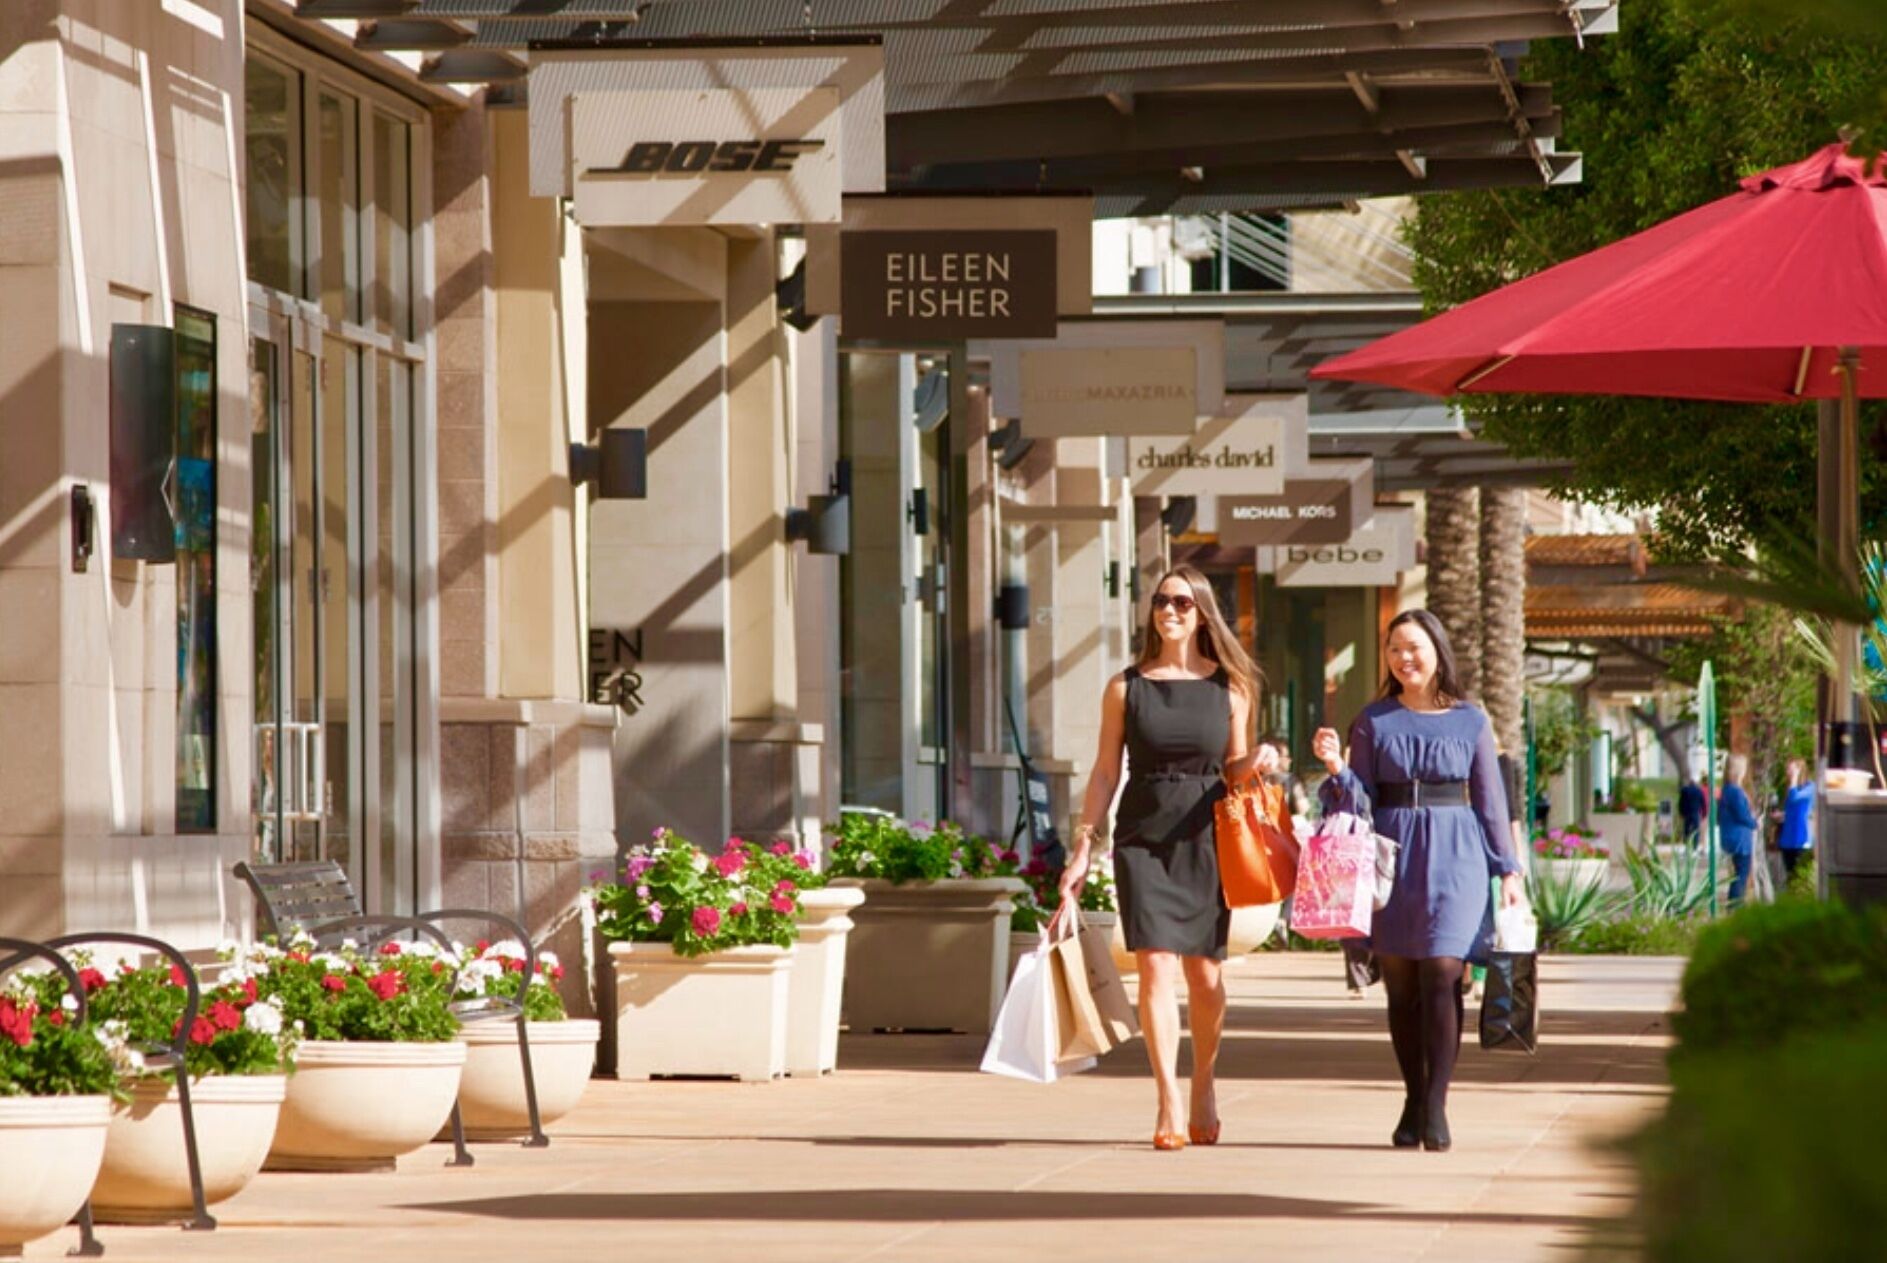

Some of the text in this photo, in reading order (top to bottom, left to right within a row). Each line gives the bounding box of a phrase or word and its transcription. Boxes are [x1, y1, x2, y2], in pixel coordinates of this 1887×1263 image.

[586, 138, 826, 174] BOSE
[886, 252, 1010, 282] EILEEN
[886, 288, 1011, 317] FISHER
[1137, 443, 1275, 469] charles david
[1232, 504, 1337, 519] MICHAEL KORS
[1288, 544, 1384, 564] bebe
